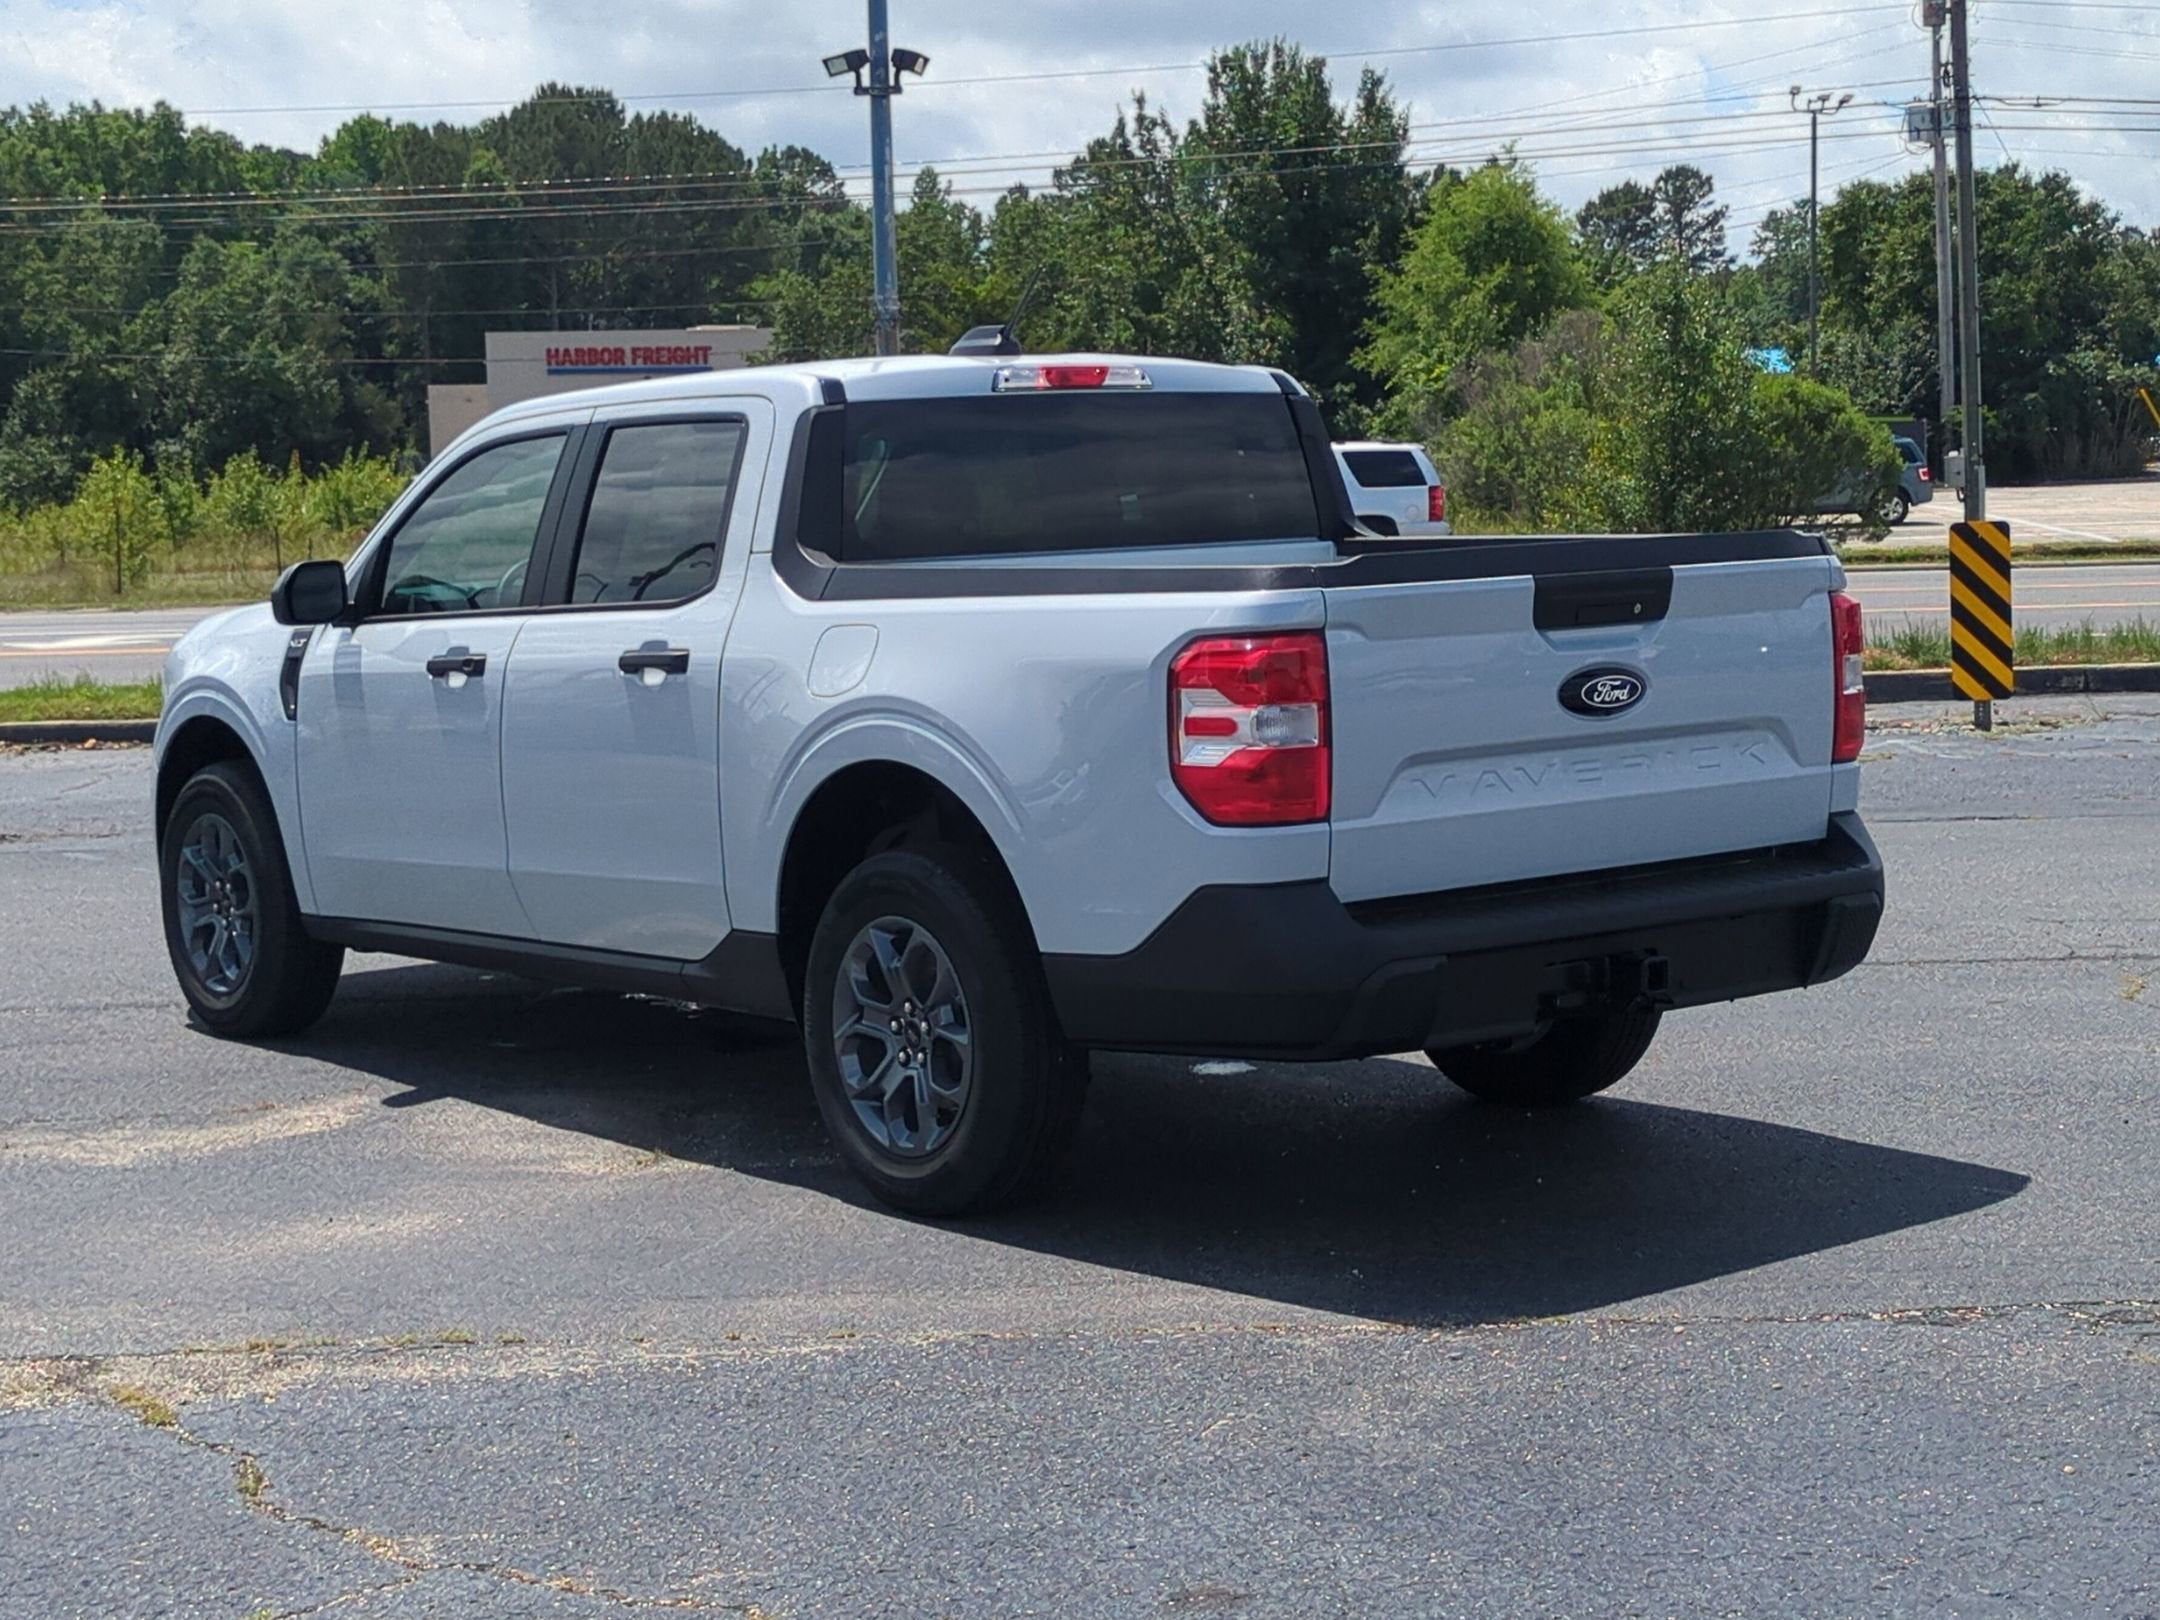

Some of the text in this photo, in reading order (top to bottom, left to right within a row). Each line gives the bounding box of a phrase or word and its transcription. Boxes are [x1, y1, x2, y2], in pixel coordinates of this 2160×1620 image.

[546, 345, 712, 366] HARBOR FREIGHT
[1593, 680, 1630, 702] Ford
[1411, 741, 1768, 800] MAVERICK
